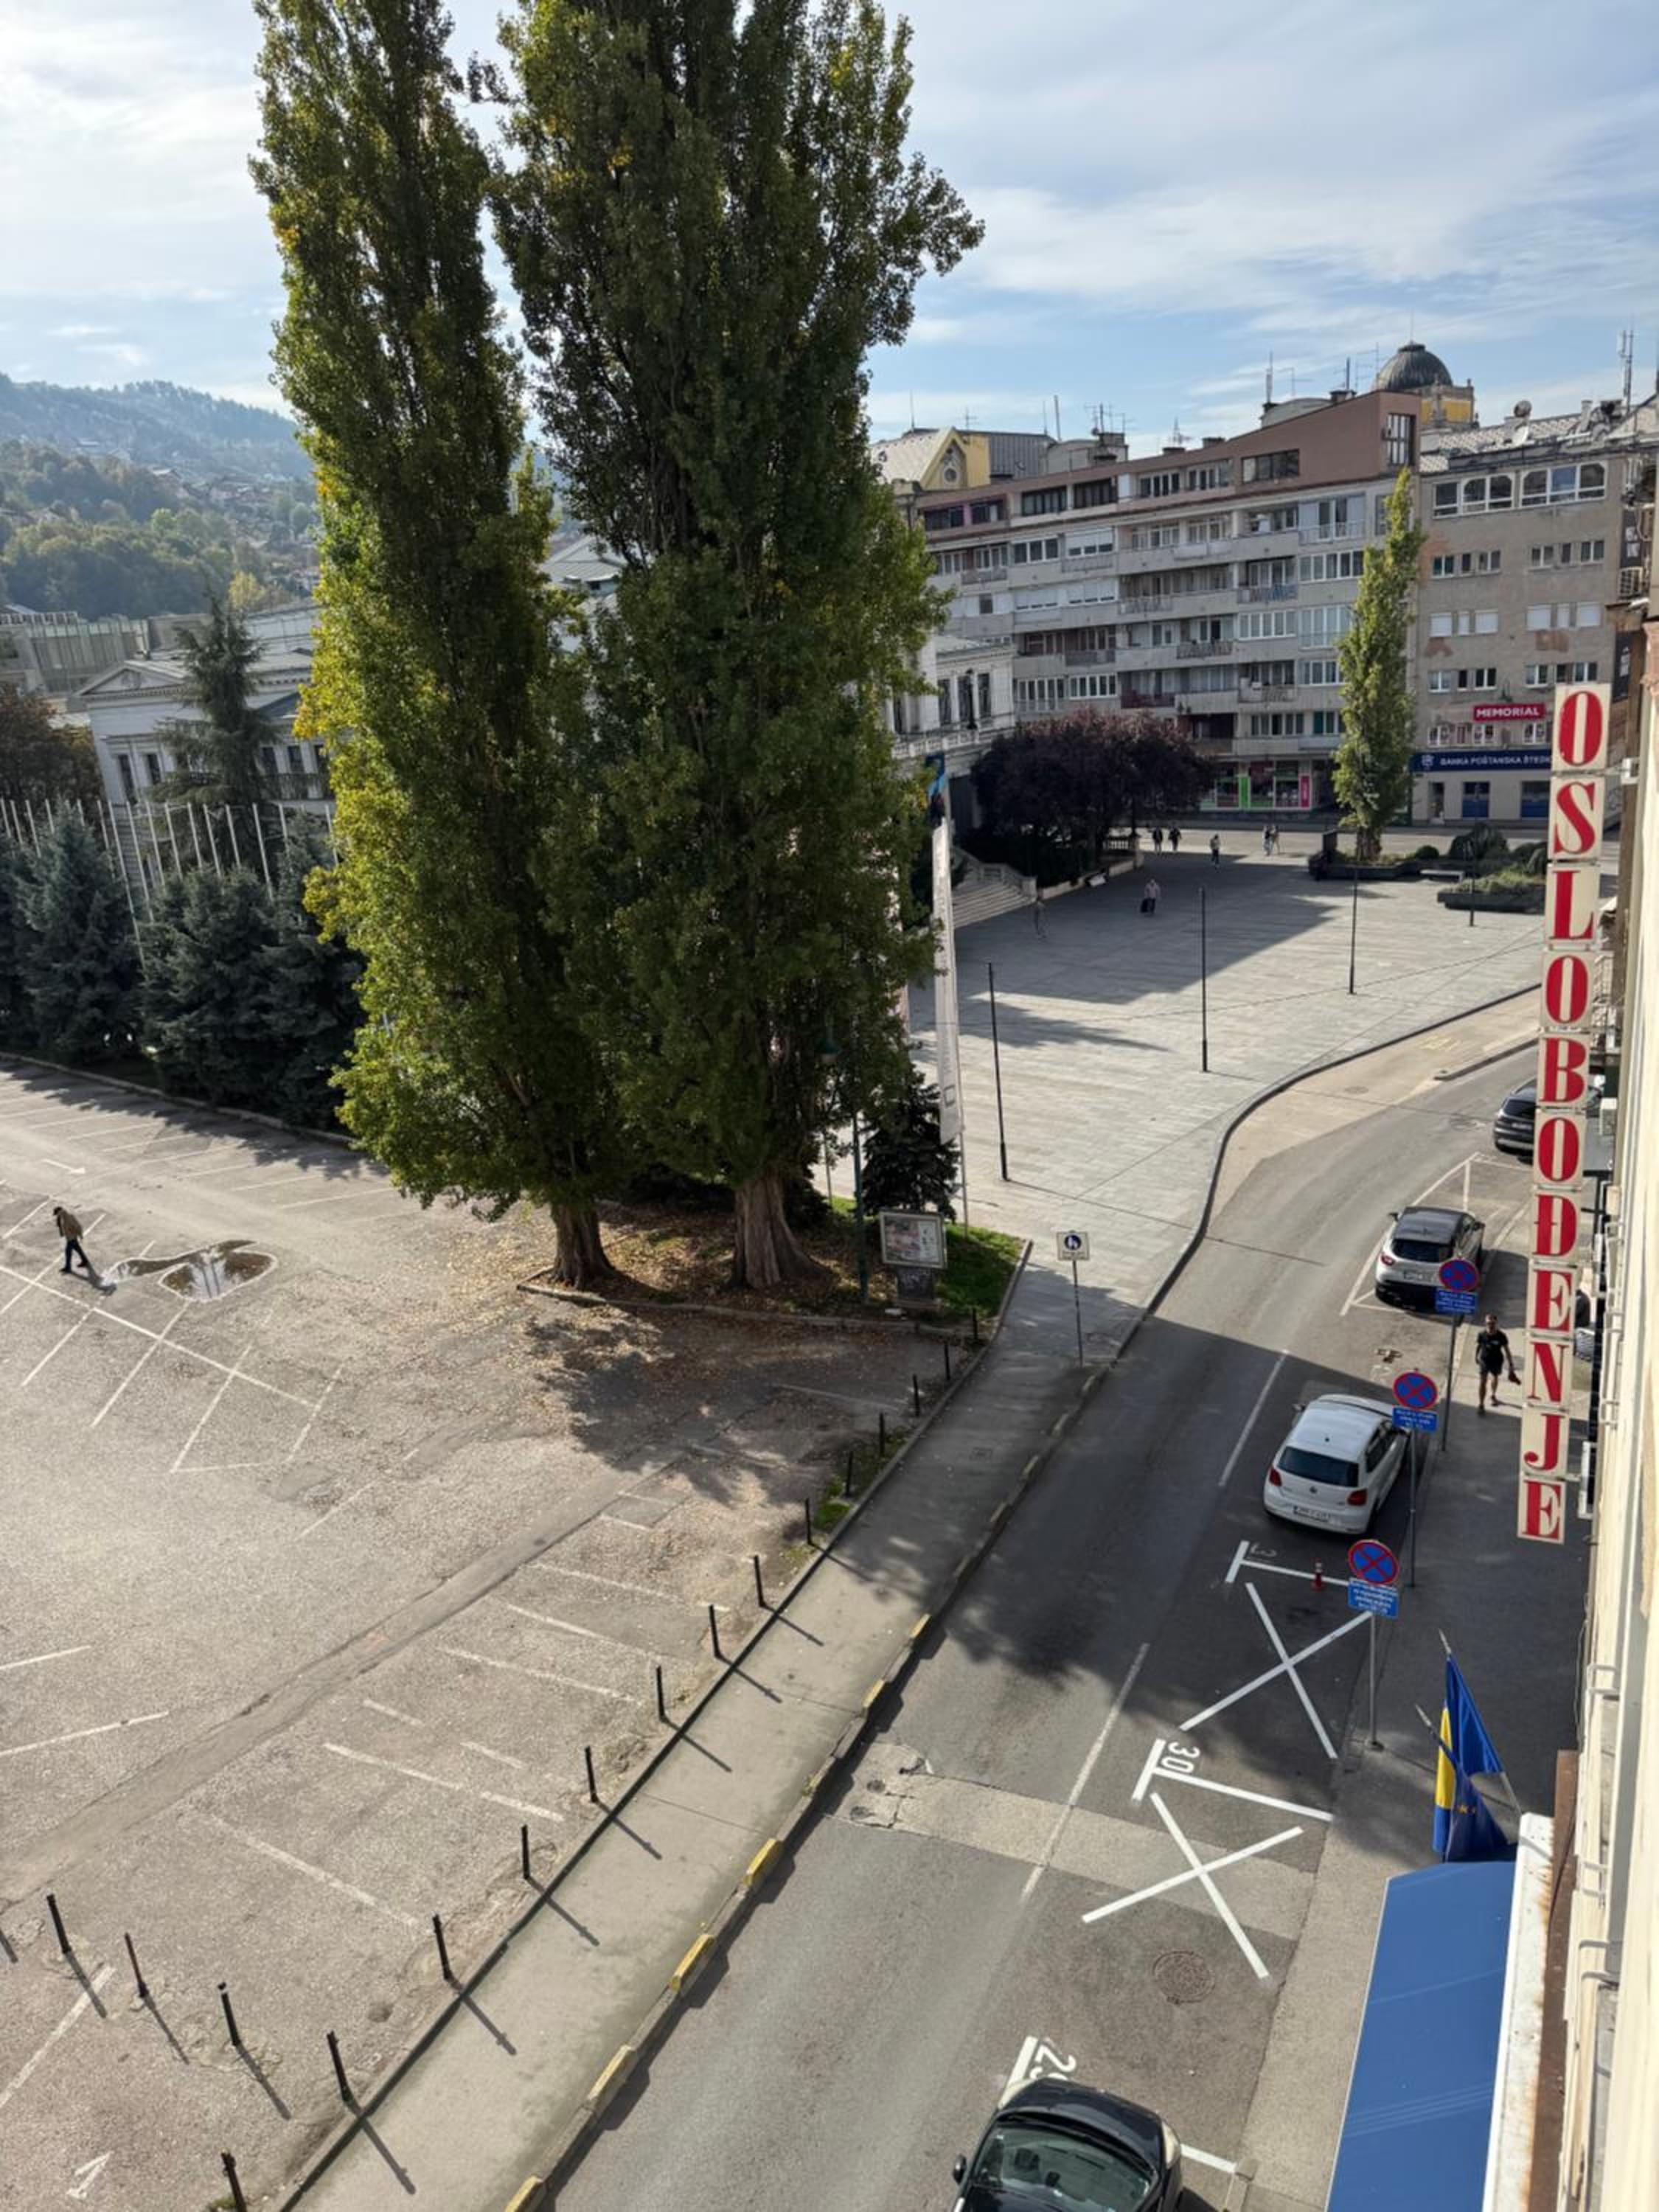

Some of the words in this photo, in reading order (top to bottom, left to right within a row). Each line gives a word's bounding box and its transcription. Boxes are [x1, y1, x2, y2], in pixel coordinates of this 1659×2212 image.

[1476, 706, 1540, 718] MEMORIAL
[1521, 690, 1603, 1540] OSLOBOĐENJE
[1161, 1742, 1200, 1773] 30
